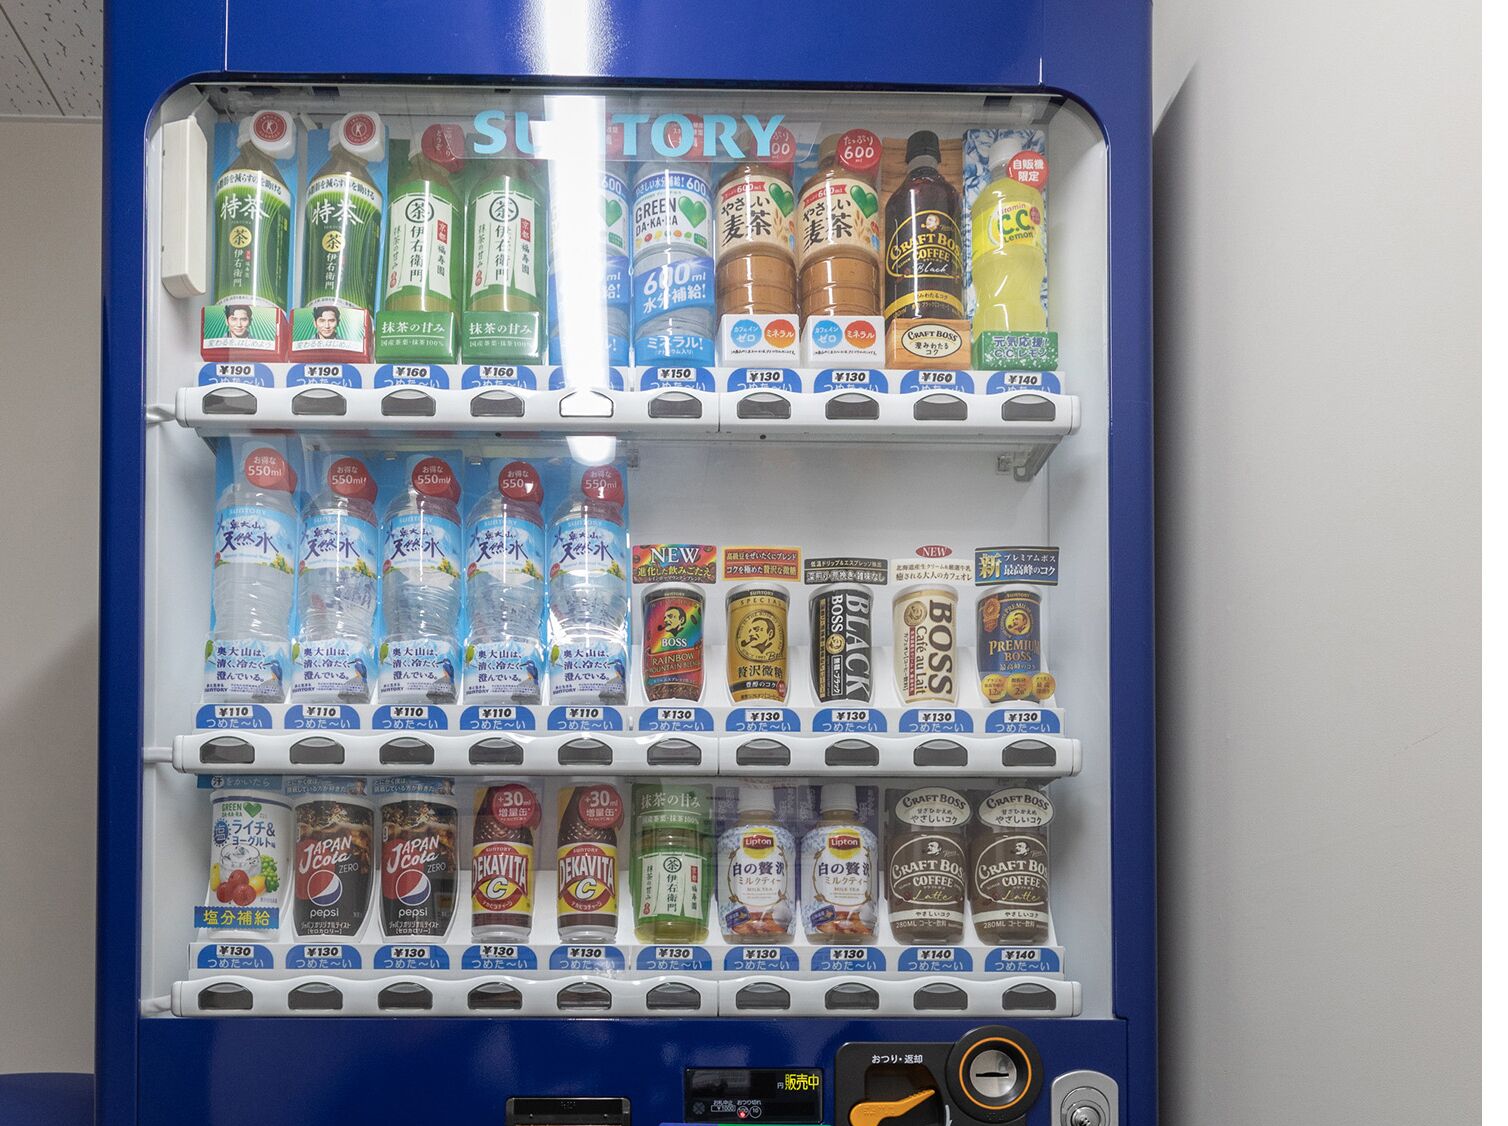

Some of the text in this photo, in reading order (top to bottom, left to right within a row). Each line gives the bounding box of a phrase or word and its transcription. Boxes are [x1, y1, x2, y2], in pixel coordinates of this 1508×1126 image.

[1013, 159, 1044, 170] 自販機
[1018, 170, 1039, 182] 限定
[221, 192, 270, 220] 特茶
[381, 321, 445, 335] 抹茶の甘み
[468, 321, 532, 335] 抹茶の甘み
[736, 334, 755, 342] ゼロ
[766, 331, 795, 339] ミネラル
[819, 335, 837, 343] ゼロ
[848, 331, 876, 339] ミネラル
[219, 365, 251, 376] ¥190
[308, 366, 339, 377] ¥190
[396, 367, 427, 378] ¥160
[483, 367, 514, 378] ¥160
[660, 369, 691, 378] ¥150
[922, 373, 953, 382] ¥160
[1009, 375, 1038, 385] ¥140
[220, 531, 279, 553] 天然水
[651, 548, 699, 563] NEW
[923, 548, 947, 556] NEW
[1004, 554, 1055, 563] プレミアムボス
[638, 566, 711, 577] 進化した飲みごたえ
[980, 554, 1001, 578] 新
[1004, 565, 1055, 576] 最高峰のコク
[662, 639, 687, 647] BOSS
[845, 594, 870, 703] BLACK
[928, 600, 953, 696] BOSS
[218, 708, 249, 717] ¥110
[307, 707, 337, 717] ¥110
[394, 707, 423, 716] ¥110
[662, 711, 692, 719] ¥130
[751, 713, 780, 721] ¥130
[923, 714, 952, 722] ¥130
[1008, 714, 1037, 722] ¥130
[903, 794, 966, 809] CRAFT BOSS
[987, 795, 1020, 809] CRAFT
[232, 820, 275, 836] ライチ&
[746, 838, 772, 846] Lipton
[831, 838, 858, 846] Lipton
[339, 864, 359, 873] ZERO
[427, 863, 446, 872] ZERO
[473, 855, 527, 890] DEKAVITA
[559, 856, 614, 892] DEKAVITA
[739, 877, 781, 885] ミルクティー
[913, 875, 953, 887] COFFEE
[1002, 875, 1041, 888] COFFEE
[487, 877, 508, 899] C
[575, 878, 596, 899] C
[203, 910, 270, 925] 塩分補給
[310, 908, 339, 918] pepsi
[219, 947, 251, 956] ¥130
[307, 947, 338, 956] ¥130
[1005, 951, 1035, 959] ¥140
[785, 1073, 820, 1090] 販売中
